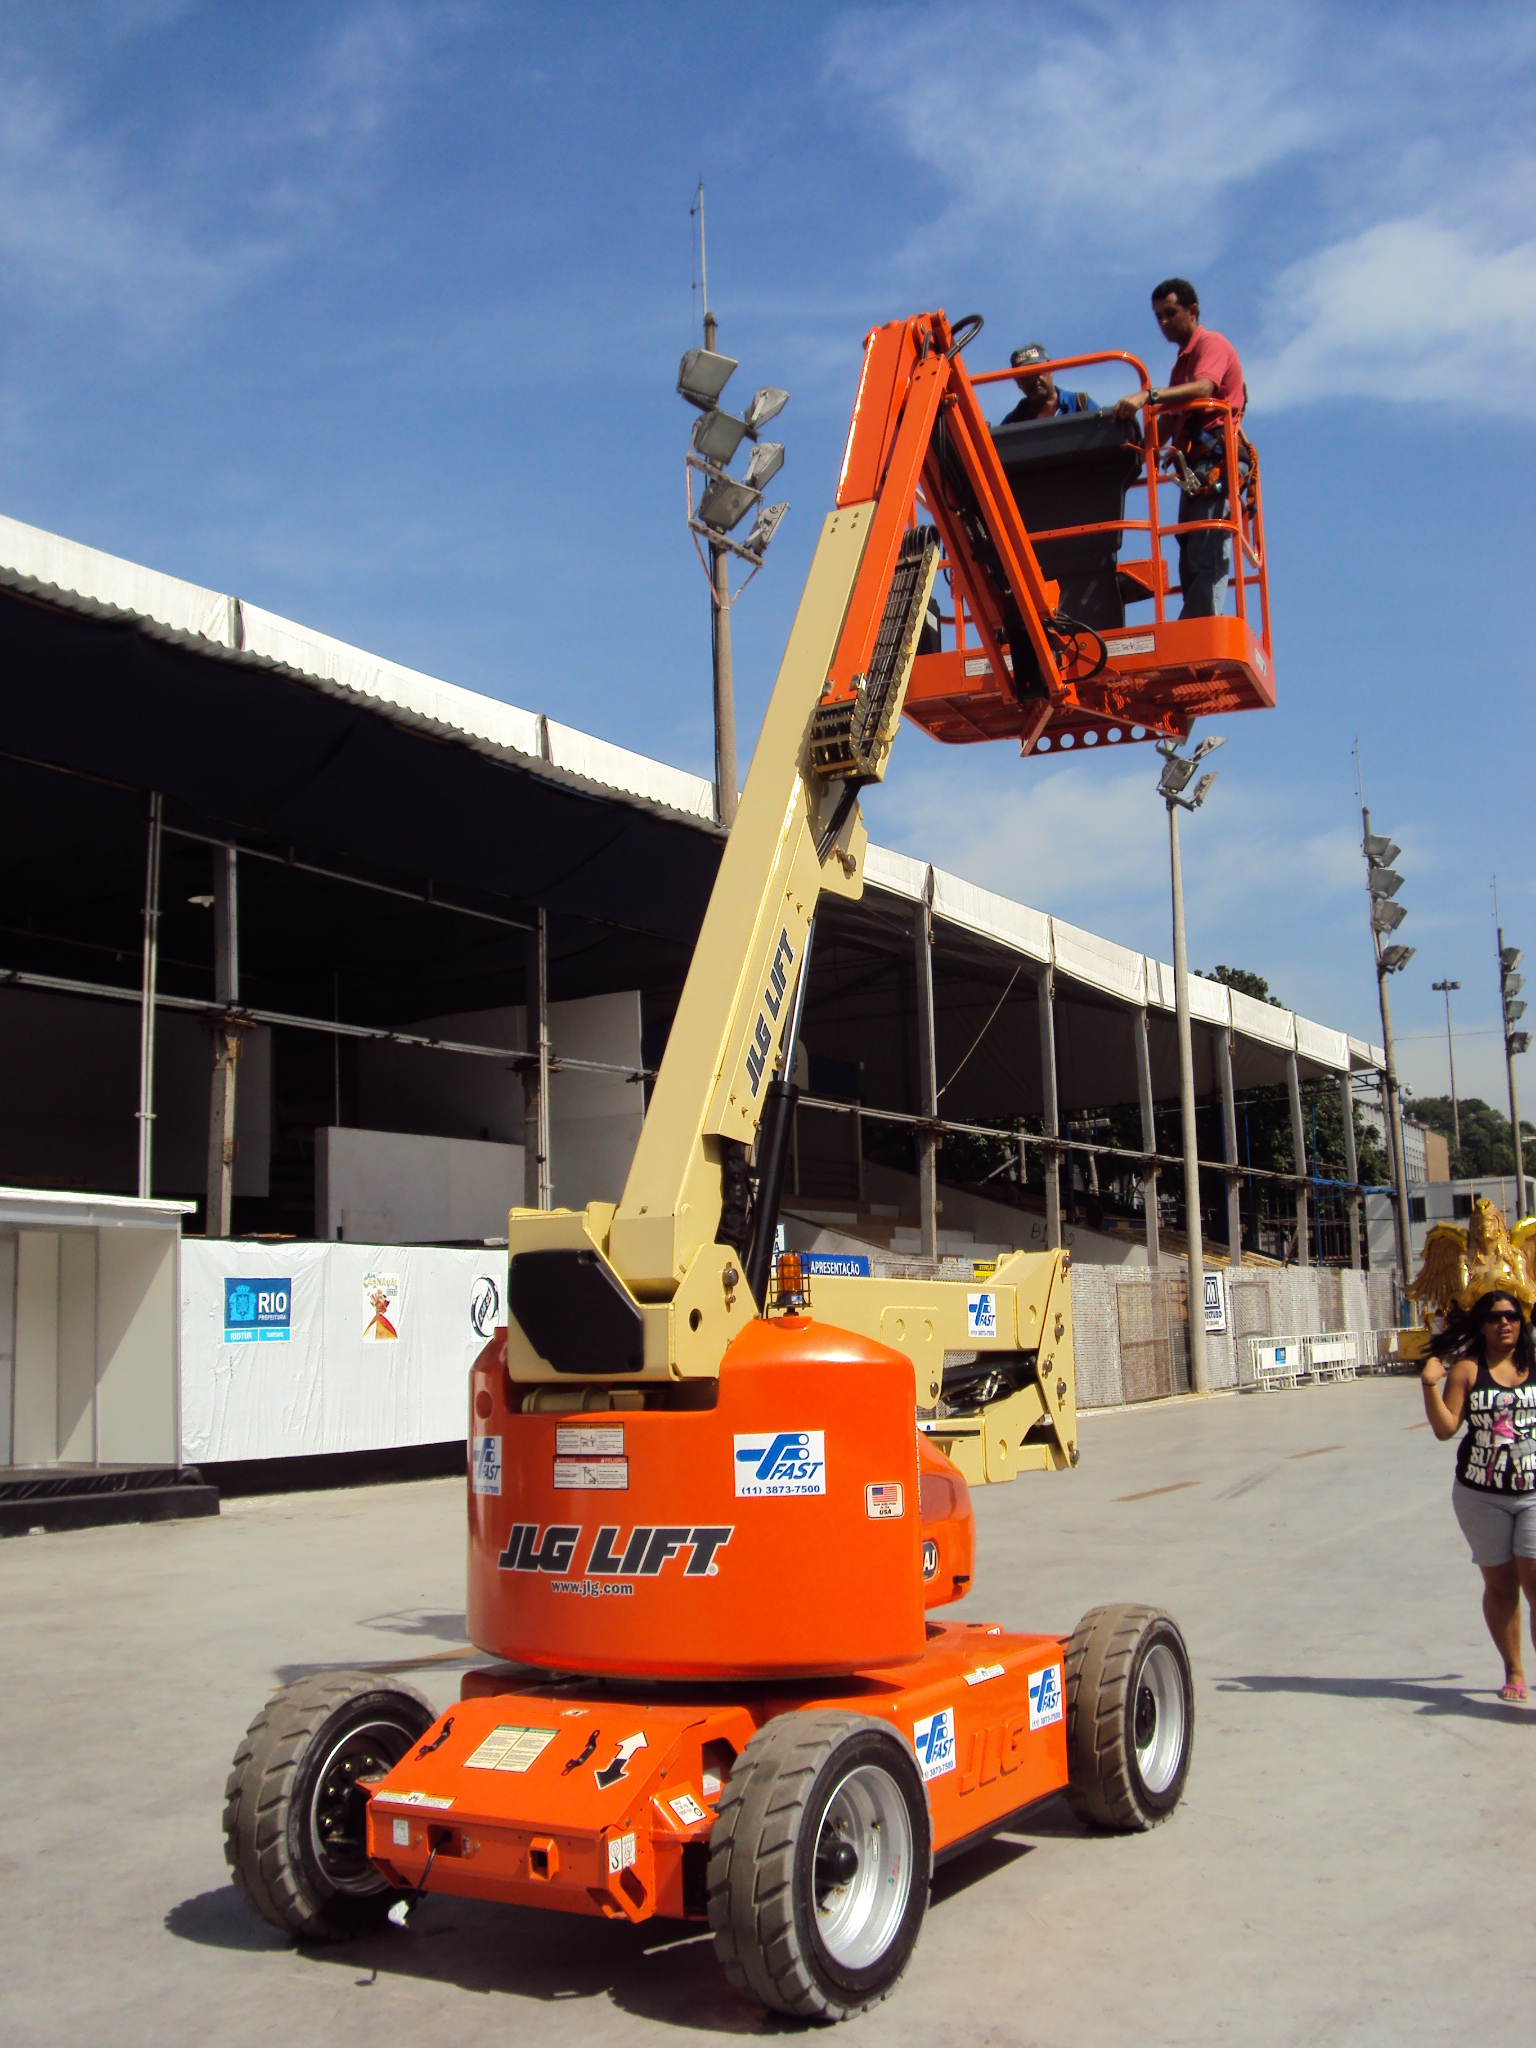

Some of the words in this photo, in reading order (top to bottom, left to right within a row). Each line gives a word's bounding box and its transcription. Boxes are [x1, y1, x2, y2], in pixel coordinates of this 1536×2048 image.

[746, 1009, 772, 1100] JLG
[764, 924, 795, 1025] LIFT
[810, 1260, 860, 1277] APRESENTAÇÃO
[258, 1292, 287, 1313] RIO
[980, 1314, 996, 1326] FAST
[230, 1332, 252, 1340] RIOTUR
[481, 1464, 501, 1480] FAST
[769, 1462, 824, 1480] FAST
[741, 1486, 762, 1494] (11)
[765, 1485, 820, 1494] 3873-7500
[498, 1523, 583, 1574] JLG
[585, 1525, 735, 1577] LIFT
[550, 1579, 634, 1597] www.jlg.com
[1042, 1691, 1061, 1712] FAST
[931, 1738, 954, 1762] FAST
[959, 1714, 1027, 1797] JLG
